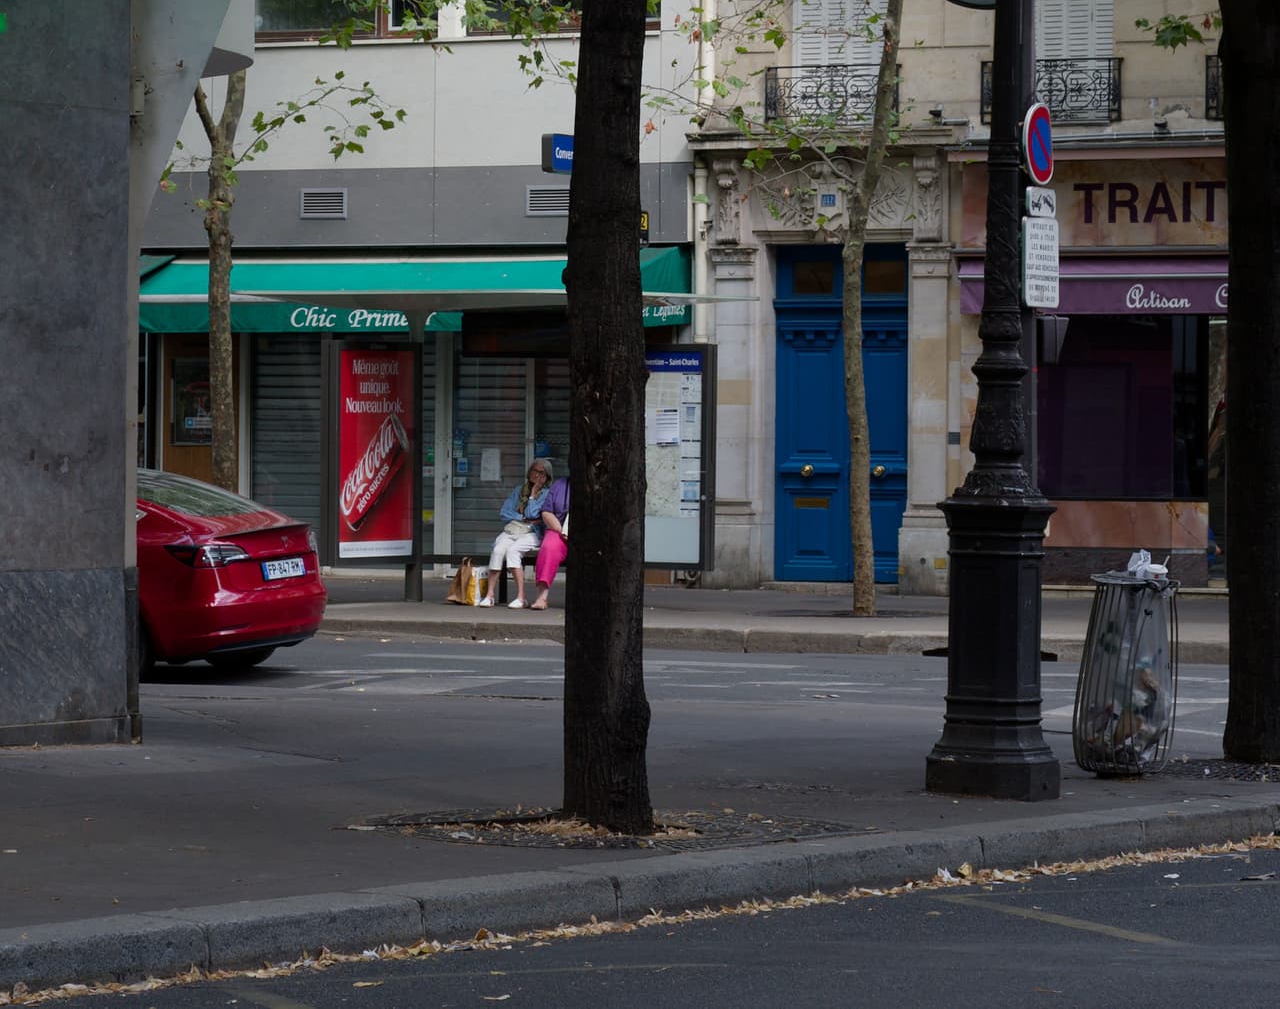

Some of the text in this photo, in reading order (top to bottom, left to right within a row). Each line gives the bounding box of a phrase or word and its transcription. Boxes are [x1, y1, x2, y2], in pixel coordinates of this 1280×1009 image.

[1126, 283, 1191, 309] Artisan
[290, 306, 437, 328] Chic Primer
[352, 359, 379, 375] Même
[346, 397, 382, 414] Nouveau
